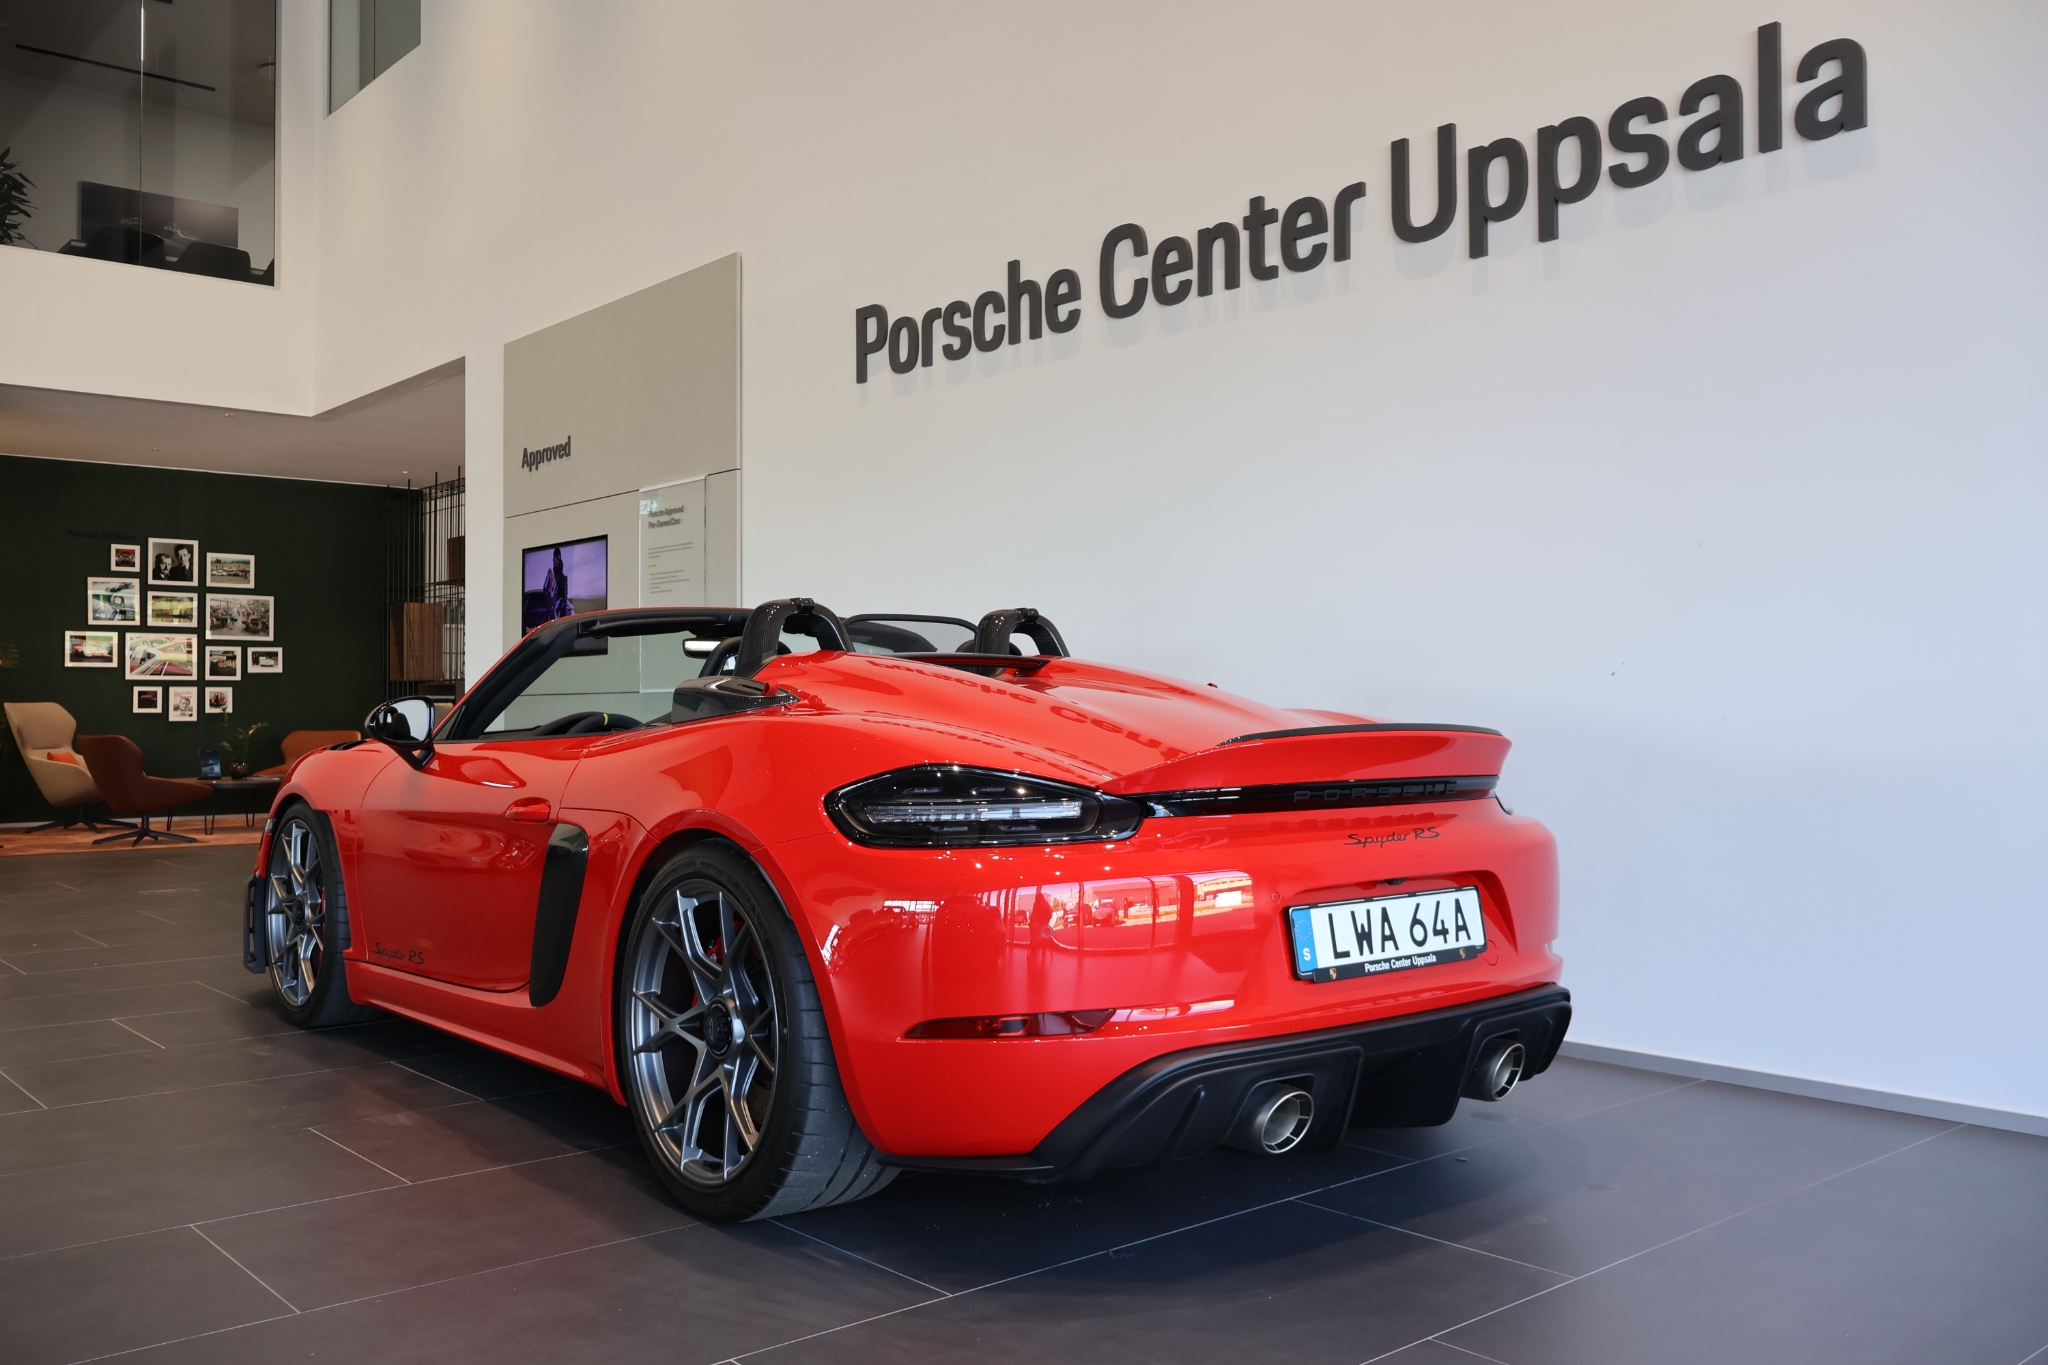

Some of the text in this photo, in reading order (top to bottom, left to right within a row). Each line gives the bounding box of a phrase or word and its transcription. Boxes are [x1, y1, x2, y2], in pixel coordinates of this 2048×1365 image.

[856, 21, 1868, 384] Porsche Center Uppsala
[521, 435, 571, 472] Approved
[1293, 782, 1458, 803] PORSCHE
[1343, 826, 1441, 849] Spyder RS
[1327, 898, 1472, 960] LWA 64A
[371, 942, 425, 966] Spyder RS
[1302, 947, 1312, 961] S
[1364, 953, 1437, 973] Porsche Center Uppsala
